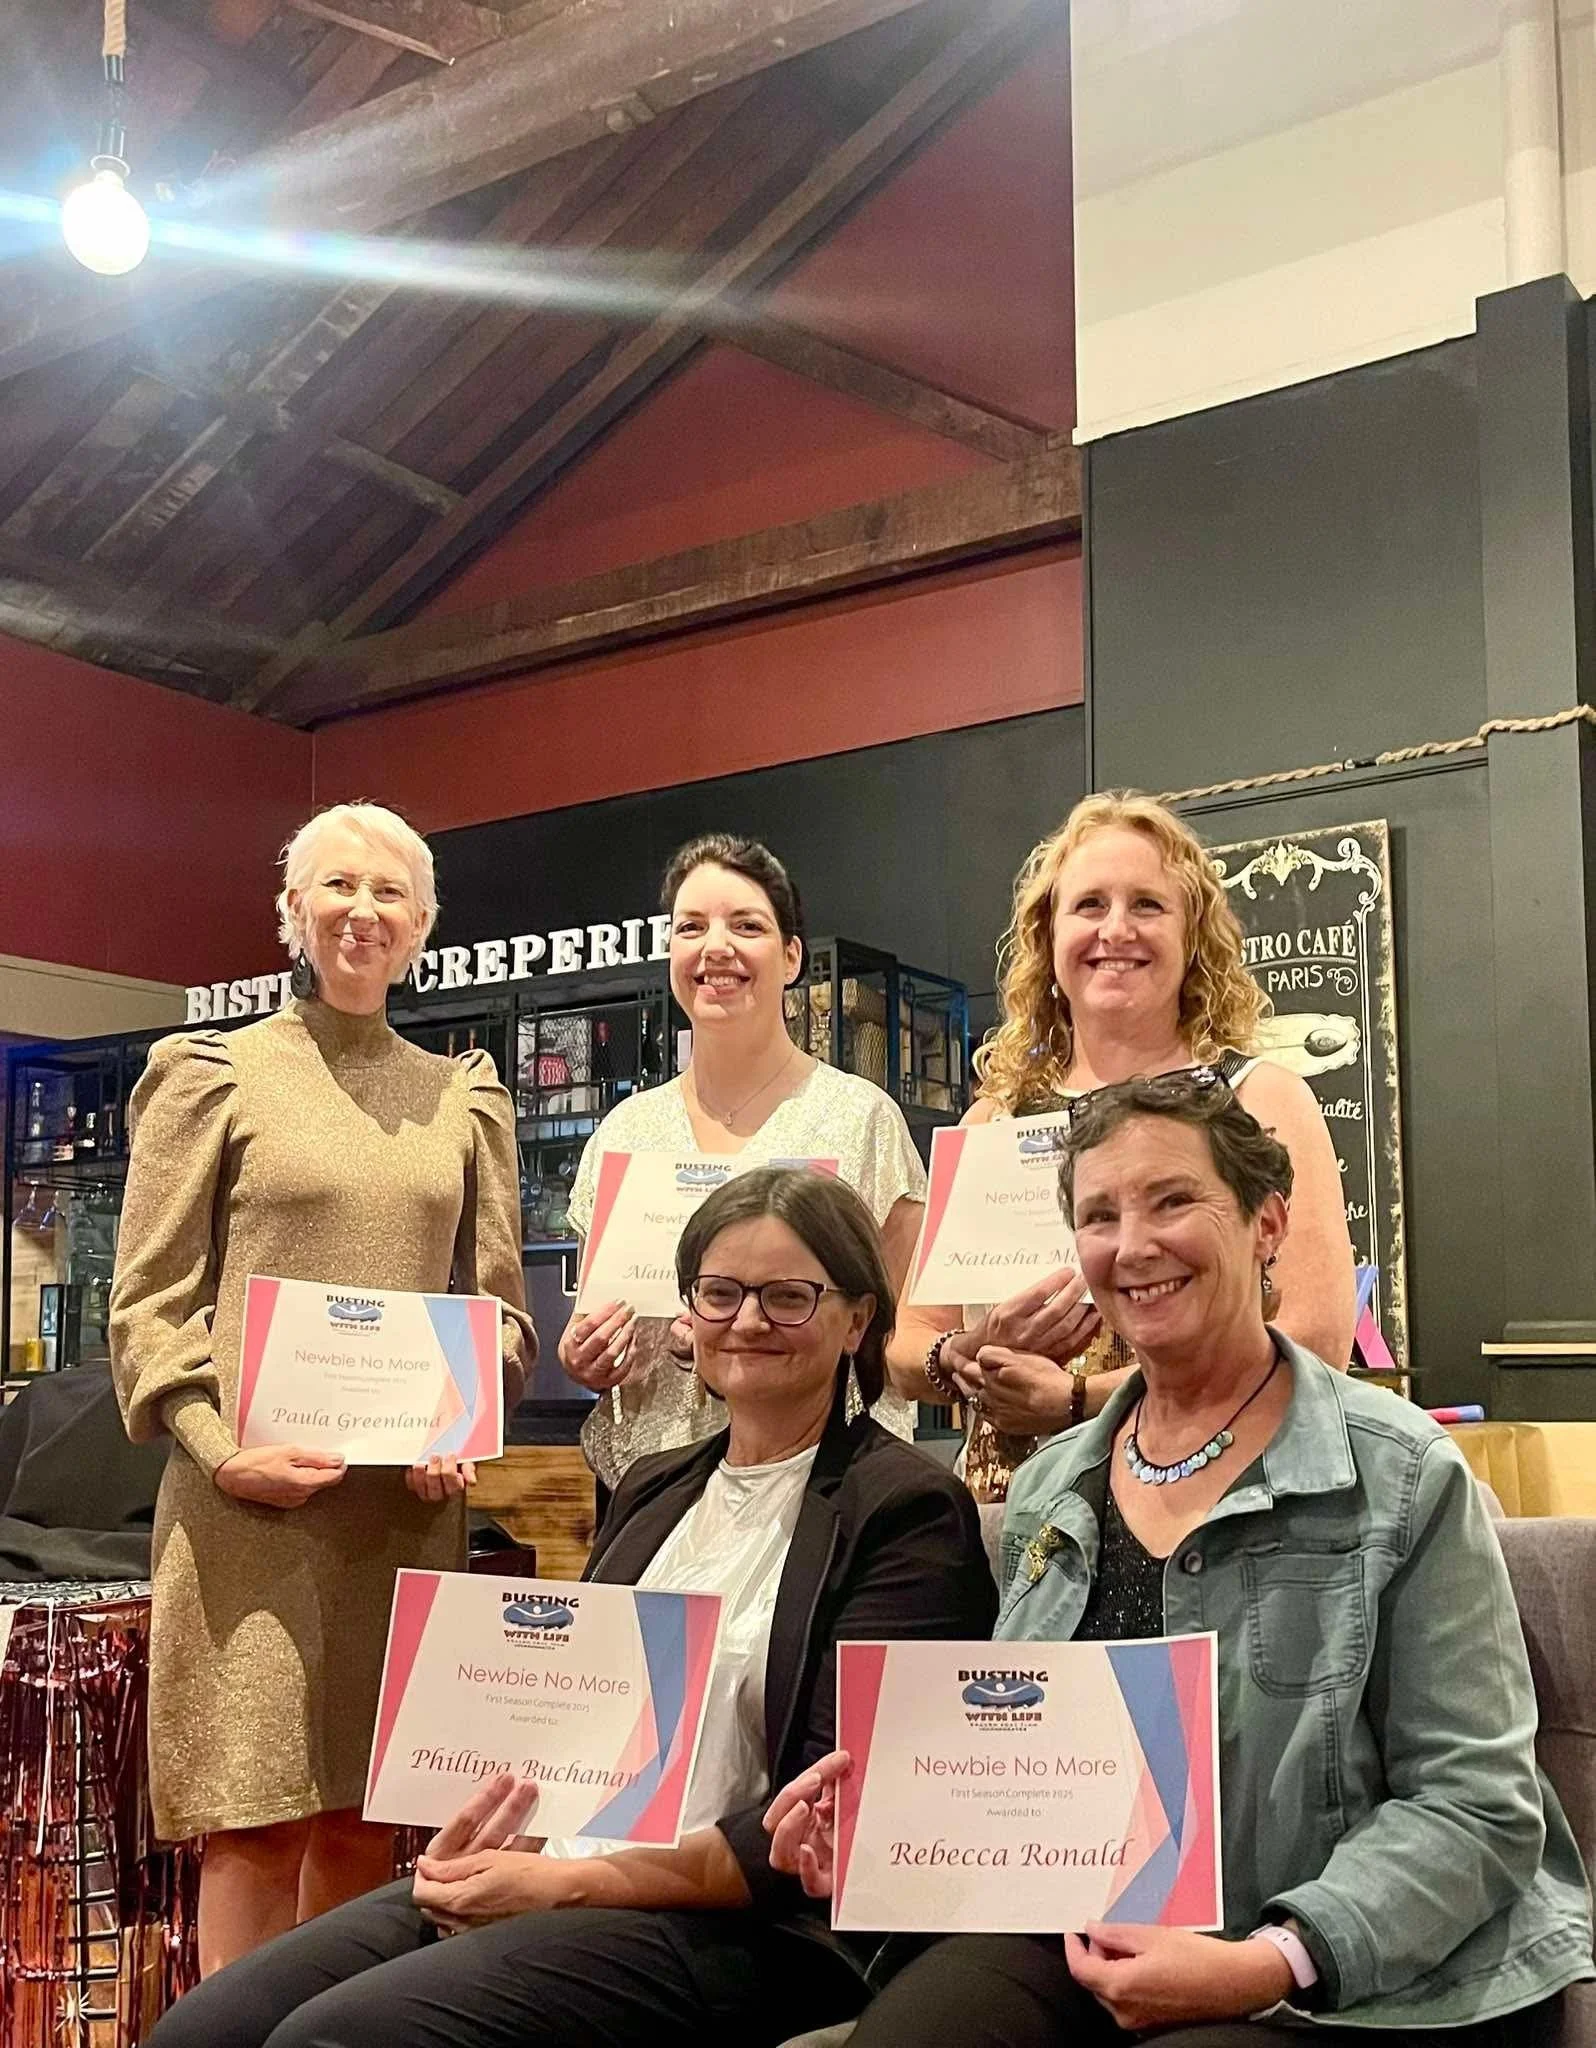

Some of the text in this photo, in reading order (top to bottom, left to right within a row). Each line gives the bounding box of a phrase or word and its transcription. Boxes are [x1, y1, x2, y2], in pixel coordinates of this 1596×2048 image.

[1297, 920, 1357, 957] CAFÉ
[409, 914, 672, 993] CREPERIE
[1267, 964, 1324, 993] PARIS
[675, 1163, 733, 1172] BUSTING
[984, 1187, 1050, 1205] Newbie
[944, 1249, 1040, 1267] Natasha
[326, 1294, 386, 1308] BUSTING
[294, 1349, 431, 1372] Newbie No More
[271, 1407, 444, 1431] Paula Greenland
[502, 1592, 580, 1608] BUSTING
[503, 1629, 540, 1640] WITH
[457, 1663, 631, 1696] Newbie No More
[958, 1670, 1049, 1682] BUSTING
[965, 1712, 1042, 1722] WITH LIFE
[410, 1747, 643, 1788] Phillipa Buchanan
[914, 1755, 1118, 1777] Newbie No More
[951, 1788, 970, 1799] First
[971, 1789, 1005, 1799] Season
[1005, 1788, 1050, 1801] Complete
[986, 1807, 1029, 1818] Awarded
[889, 1838, 1135, 1867] Rebecca Ronald
